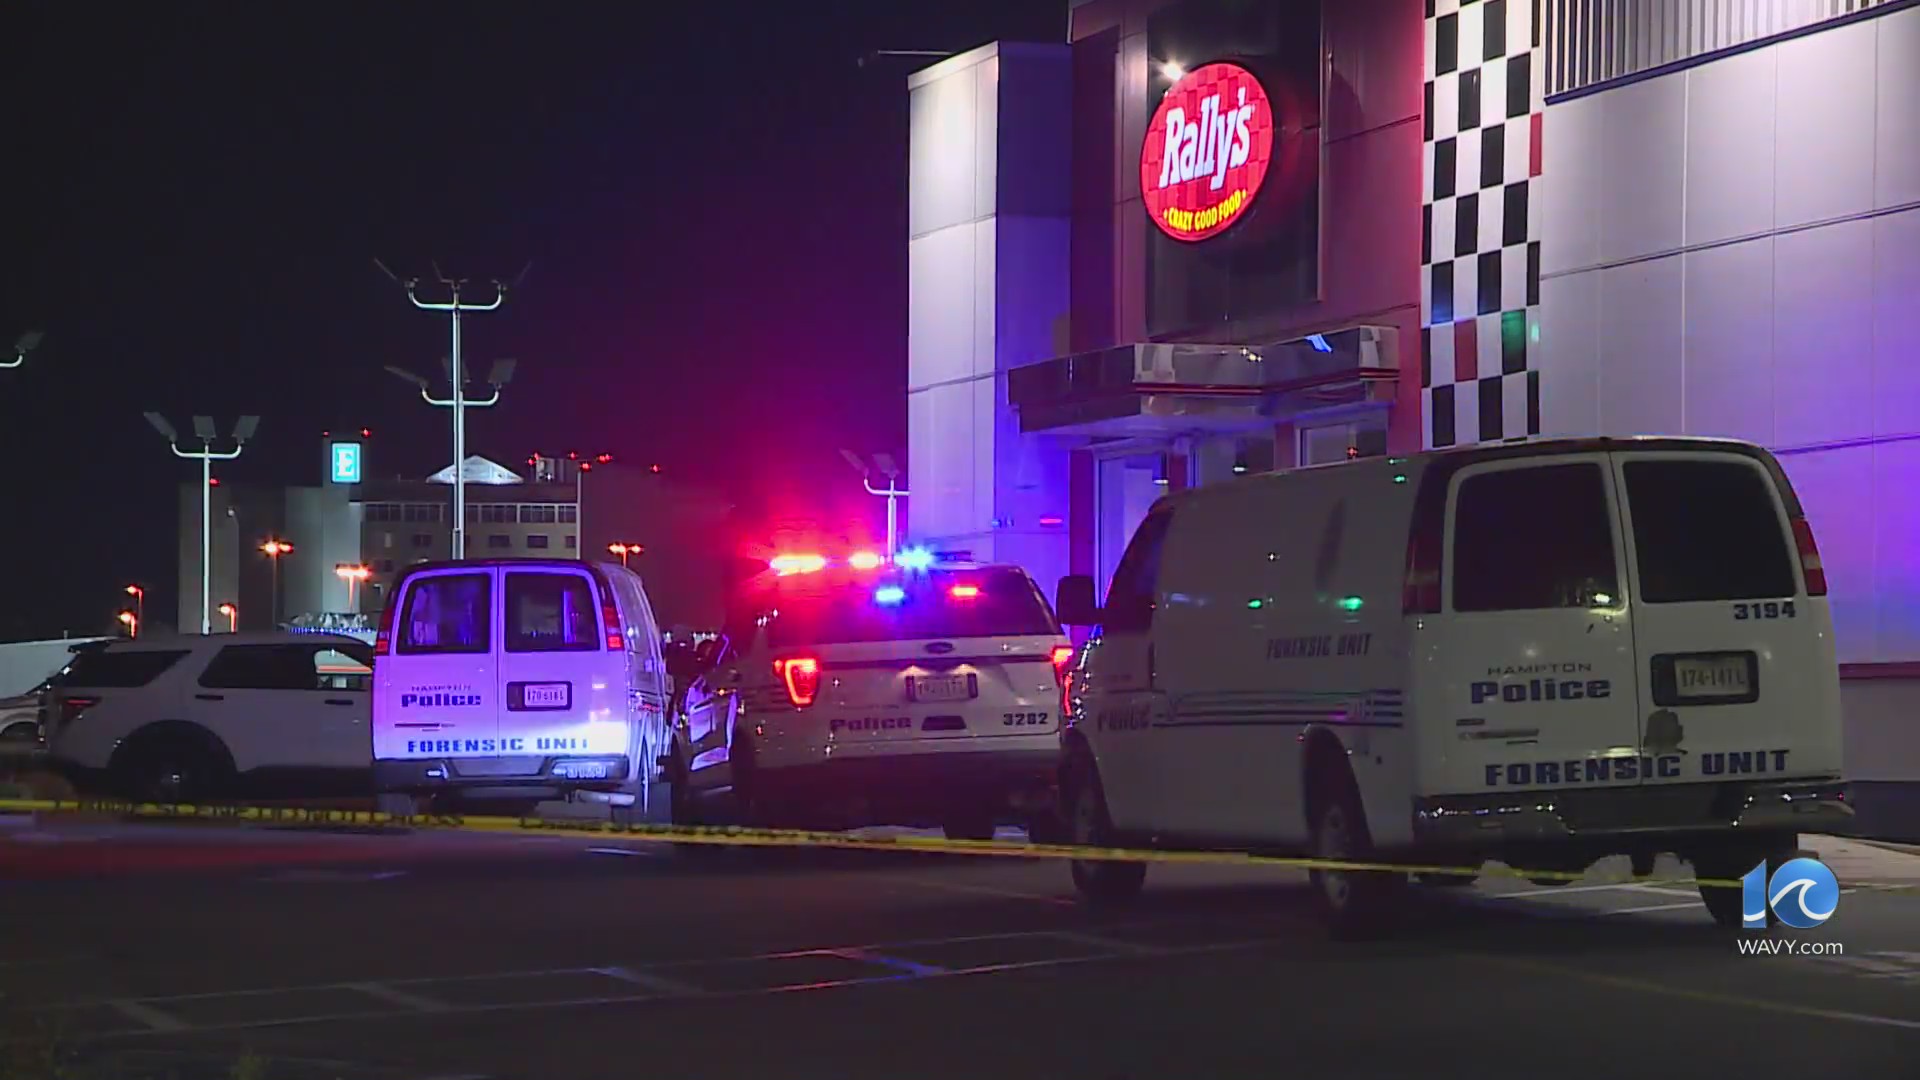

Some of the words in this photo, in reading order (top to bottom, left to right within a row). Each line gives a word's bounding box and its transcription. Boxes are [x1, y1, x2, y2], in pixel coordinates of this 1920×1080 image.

[1158, 86, 1254, 191] Rally's
[1168, 207, 1193, 232] CRAZY
[1194, 207, 1218, 232] GOOD
[1218, 191, 1242, 222] FOOD
[337, 451, 355, 477] E
[1733, 601, 1797, 621] 3194
[1266, 635, 1332, 660] FORENSIC
[1337, 632, 1373, 657] UNIT
[1487, 662, 1592, 675] HAMPTON
[401, 693, 482, 707] Police
[1471, 678, 1611, 704] Police
[829, 715, 912, 732] Police
[407, 738, 524, 753] FORENSIC
[536, 737, 589, 751] UNIT
[1484, 755, 1681, 787] FORENSIC
[1701, 749, 1791, 776] UNIT
